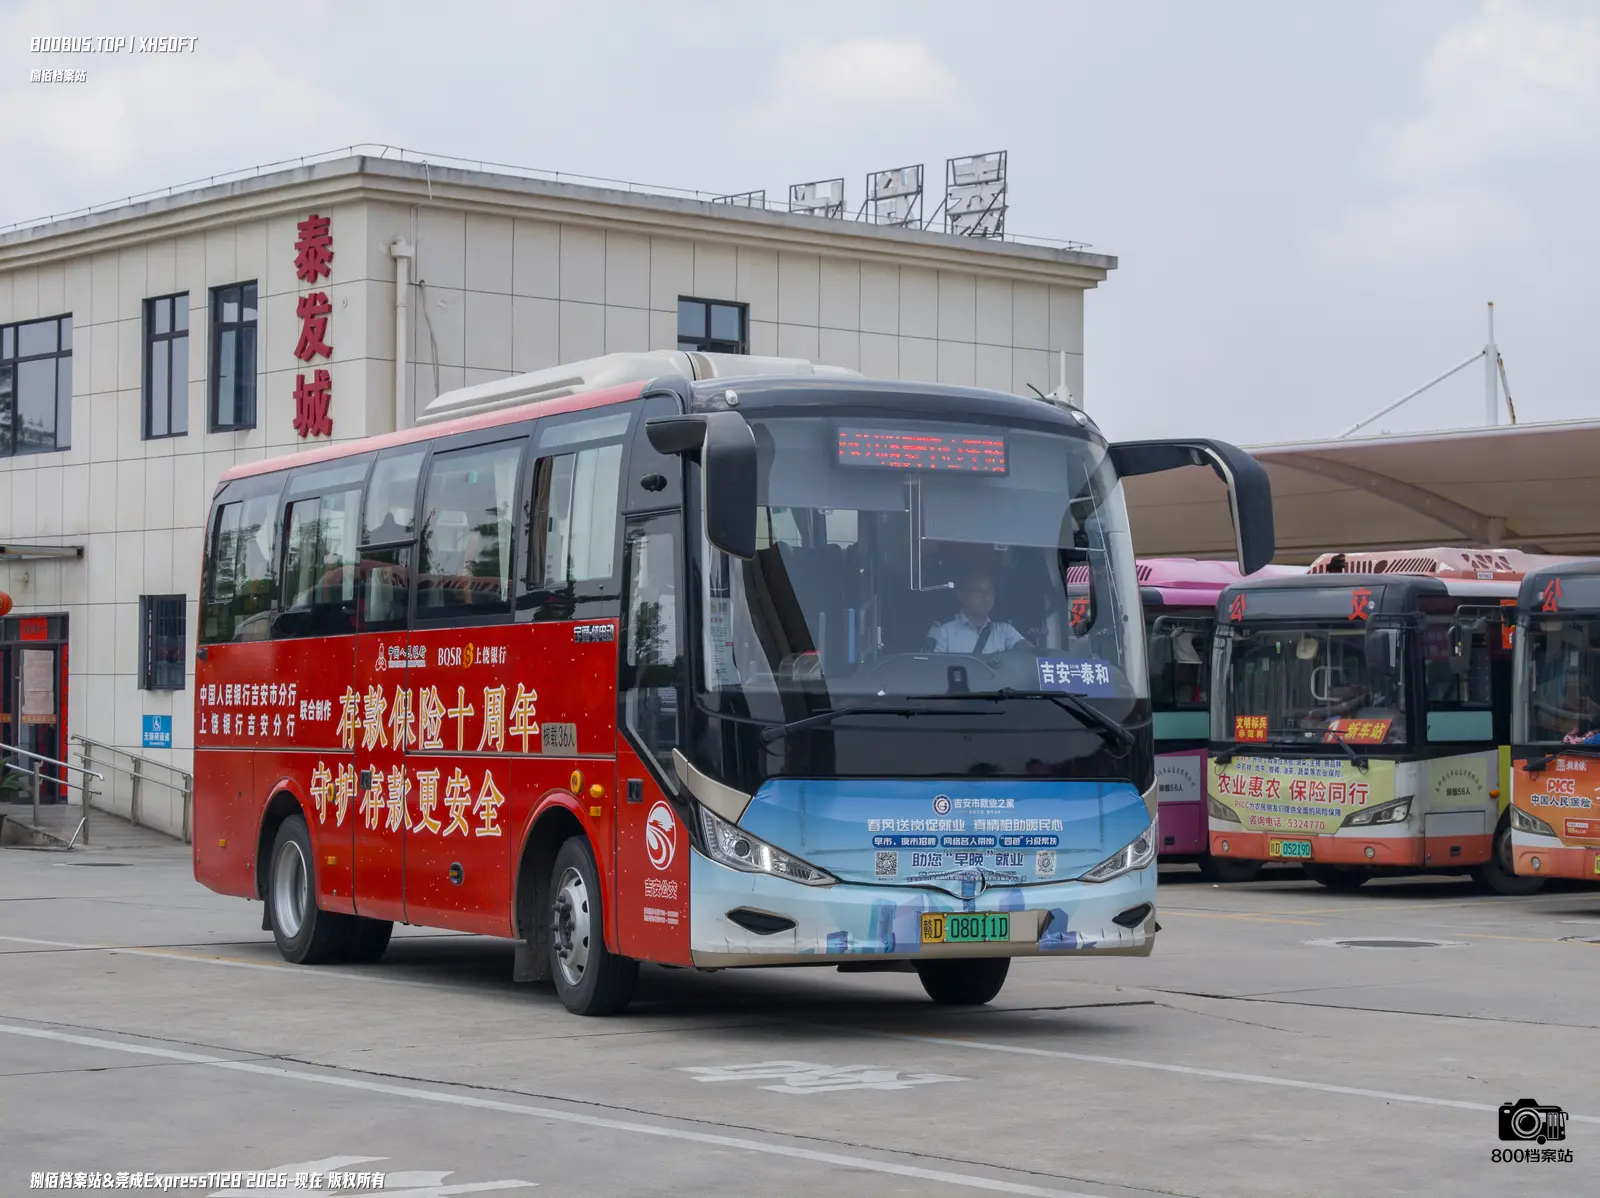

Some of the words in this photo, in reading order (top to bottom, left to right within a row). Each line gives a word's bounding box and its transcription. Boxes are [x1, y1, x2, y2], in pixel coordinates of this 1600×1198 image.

[293, 214, 334, 438] 泰发城
[1230, 592, 1247, 622] 公
[1347, 586, 1373, 621] 交
[1542, 577, 1563, 612] 公
[438, 647, 462, 666] BOSR
[474, 646, 507, 665] 上饶银行
[199, 683, 297, 706] 中国人民银行吉安市分行
[300, 699, 332, 722] 联合制作
[336, 682, 540, 753] 存款保险十周年
[199, 713, 296, 737] 上饶银行吉安分行
[1236, 717, 1267, 729] 文明标兵
[1344, 722, 1386, 740] 新车站
[1218, 773, 1280, 799] 农业惠农
[1289, 779, 1369, 804] 保险同行
[1546, 778, 1575, 794] PICC
[310, 761, 505, 837] 守护存款更安全
[954, 798, 1015, 809] 吉安市就业之家
[1531, 795, 1592, 808] 中国人民保险
[867, 819, 965, 832] 春风送岗促就业
[973, 819, 1064, 832] 真情相助暖民心
[644, 878, 678, 899] 吉安公交
